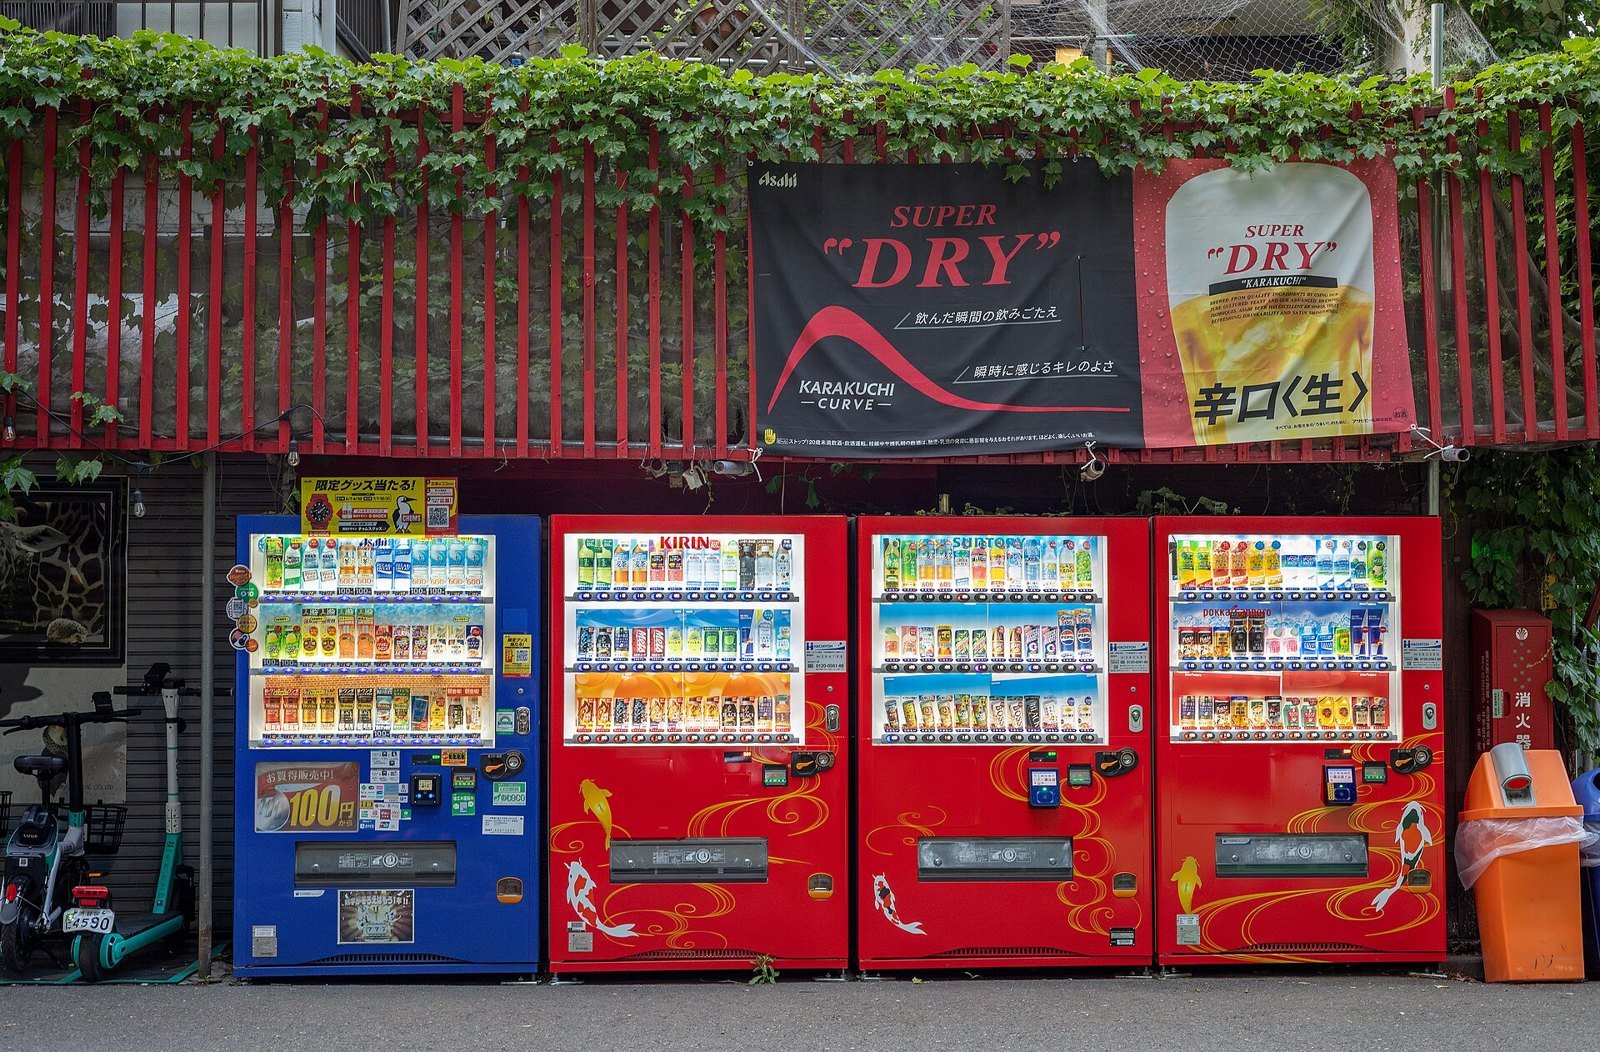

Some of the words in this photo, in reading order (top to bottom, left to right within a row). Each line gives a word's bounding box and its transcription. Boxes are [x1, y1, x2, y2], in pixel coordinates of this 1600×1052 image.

[758, 171, 798, 188] Asahi
[890, 204, 997, 228] SUPER
[1245, 224, 1304, 238] SUPER
[914, 306, 1058, 325] 飲んだ瞬間の飲みごたえ
[974, 360, 1114, 379] 瞬時に感じるキレのよさ
[798, 380, 895, 396] KARAKUCHI
[818, 397, 874, 410] CURVE
[660, 536, 709, 549] KIRIN
[266, 770, 334, 783] お買得販売中!
